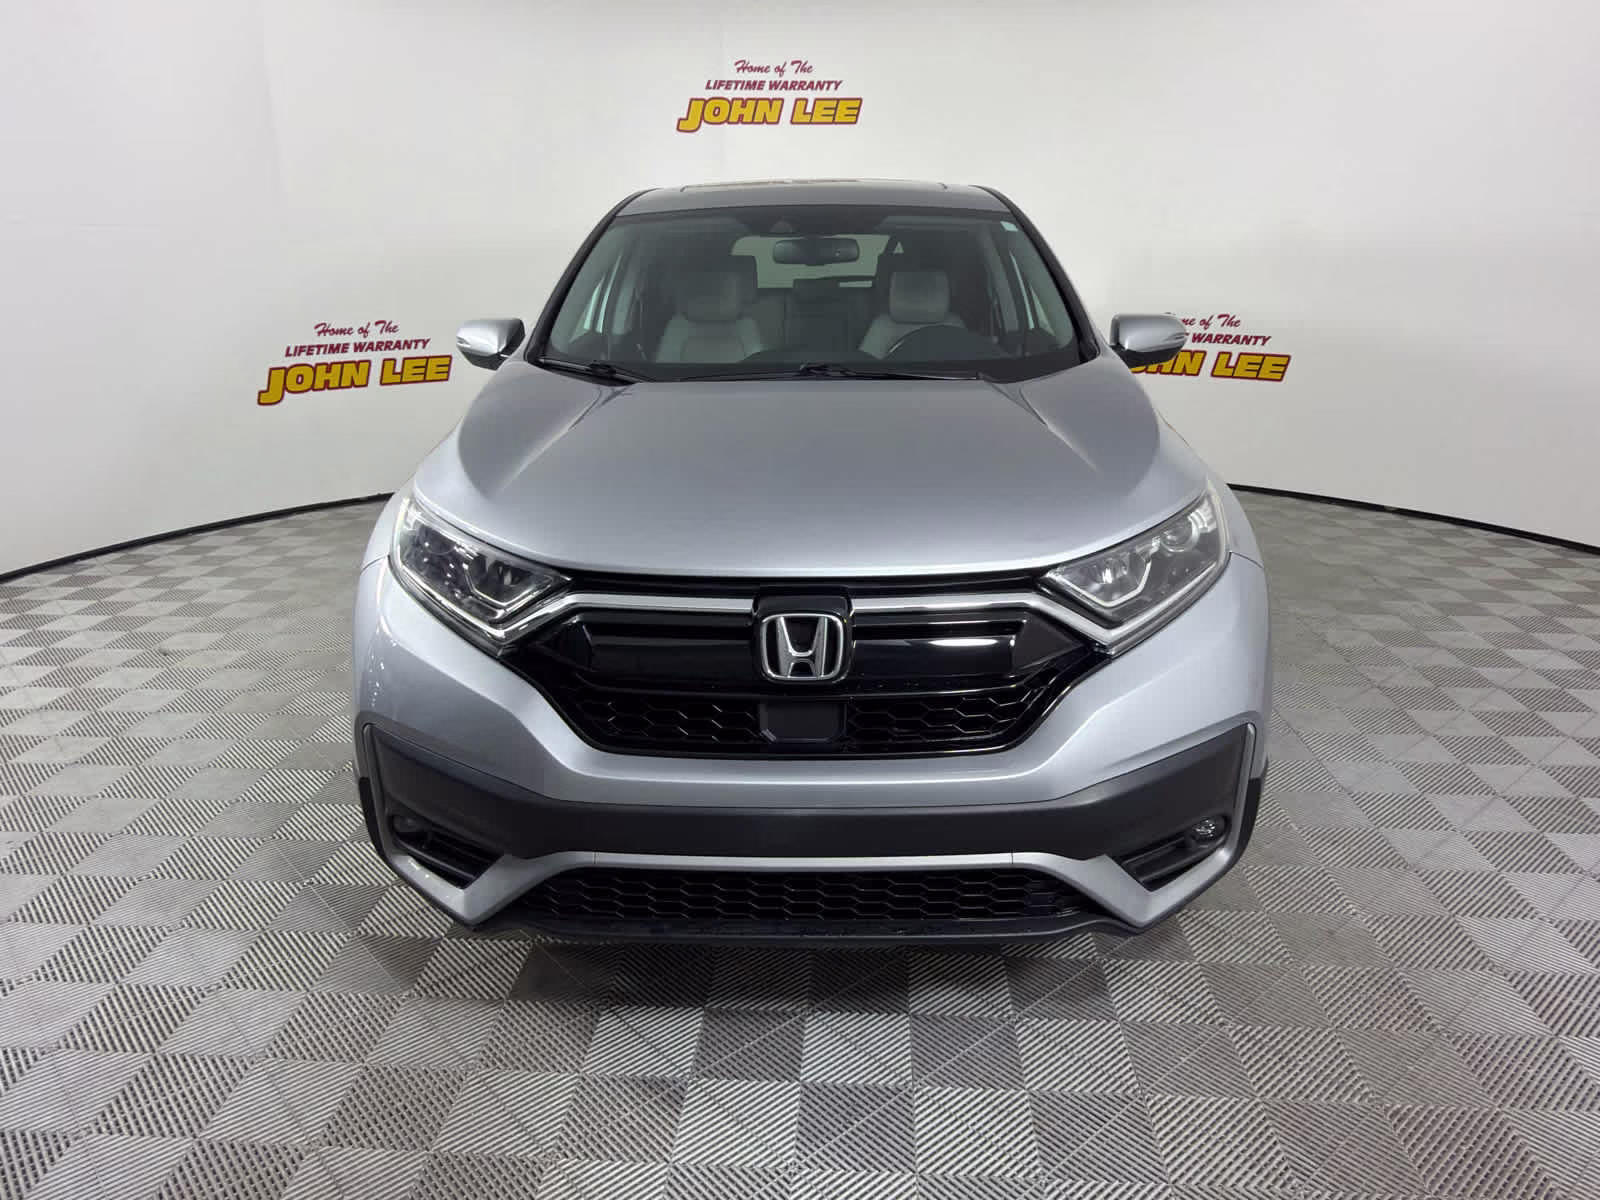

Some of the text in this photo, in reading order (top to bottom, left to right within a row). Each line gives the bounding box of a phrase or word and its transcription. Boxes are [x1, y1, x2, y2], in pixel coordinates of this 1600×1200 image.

[734, 59, 813, 77] Home of The
[705, 79, 843, 91] LIFETIME WARRANTY
[676, 97, 863, 133] JOHN LEE
[314, 319, 399, 338] Home of The
[1199, 314, 1214, 330] of
[1217, 313, 1241, 328] The
[285, 337, 431, 357] LIFETIME WARRANTY
[1191, 332, 1272, 346] WARRANTY
[1210, 351, 1292, 382] LEE
[257, 354, 453, 406] JOHN LEE
